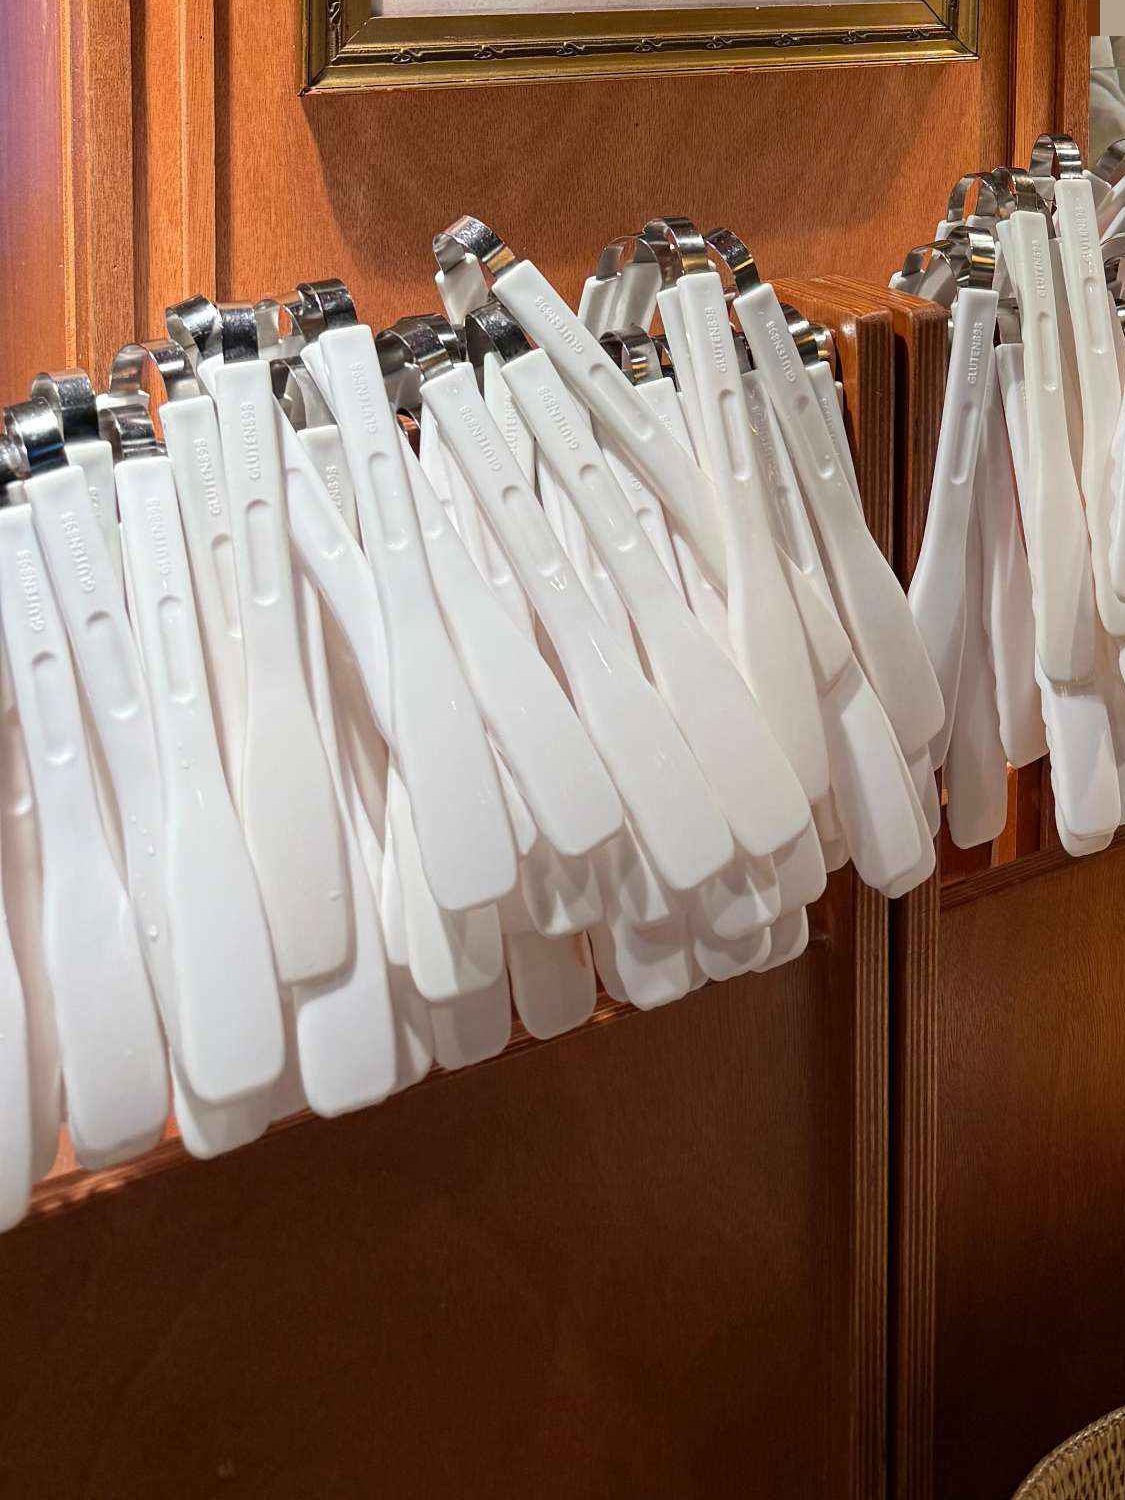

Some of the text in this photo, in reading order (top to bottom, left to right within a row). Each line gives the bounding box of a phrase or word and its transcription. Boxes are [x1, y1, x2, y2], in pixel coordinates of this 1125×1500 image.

[1075, 205, 1092, 262] GLUTEN898
[1031, 239, 1046, 297] GLUTEN898
[536, 295, 586, 356] GLUTEN898
[704, 306, 728, 374] GLUTEN898
[765, 320, 797, 383] GLUTEN898
[967, 322, 984, 385] GLUTEN898
[351, 363, 379, 435] GLUTEN898
[538, 387, 581, 452] GLUTEN898
[240, 401, 262, 481] GLUTEN898
[459, 404, 503, 473] GLUTEN898
[194, 436, 222, 518] GLUTEN898
[60, 510, 96, 595] GLUTEN898
[145, 496, 173, 577] GLUTEN898
[16, 549, 46, 633] GLUTEN898
